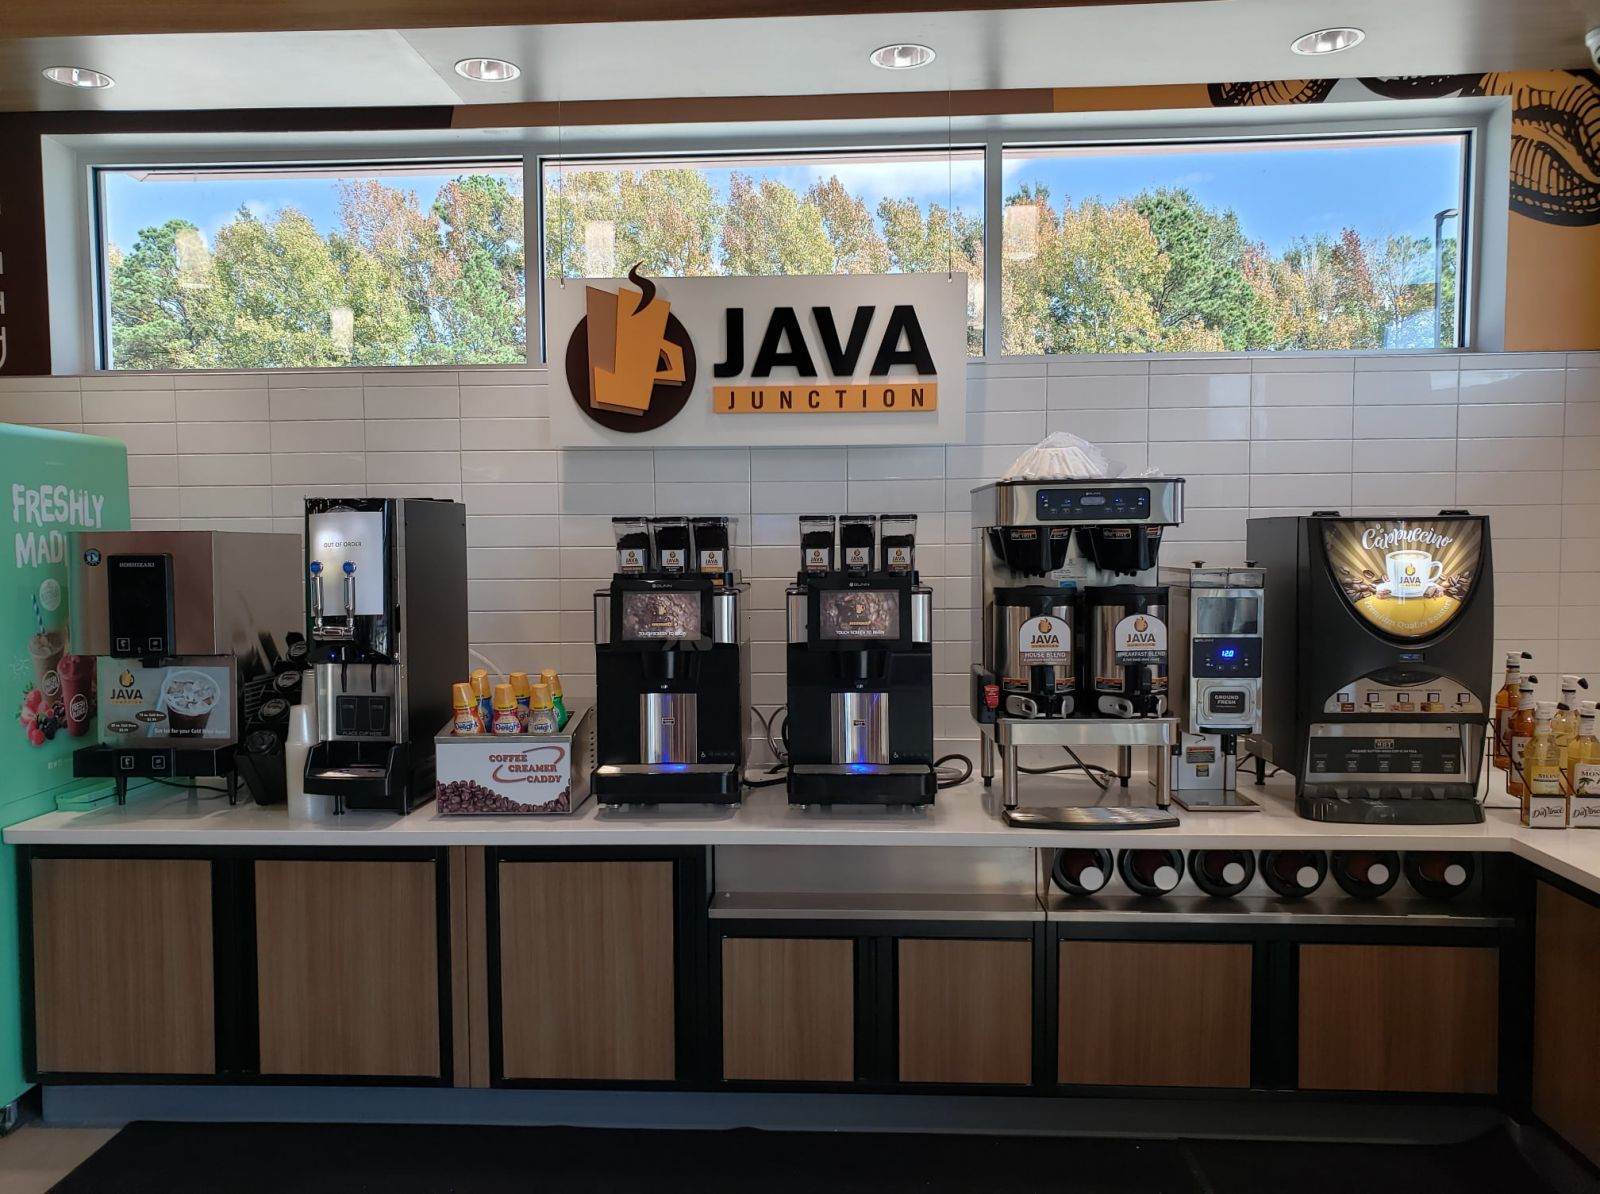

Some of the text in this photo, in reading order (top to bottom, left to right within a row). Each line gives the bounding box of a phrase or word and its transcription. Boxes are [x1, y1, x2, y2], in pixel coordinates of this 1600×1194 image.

[713, 304, 938, 379] JAVA
[727, 387, 925, 410] JUNCTION
[11, 483, 105, 529] FRESHLY
[1362, 527, 1453, 550] Cappuccino
[15, 530, 68, 569] MAD
[1400, 576, 1421, 584] JAVA
[1030, 634, 1060, 644] JAVA
[1126, 633, 1156, 643] JAVA
[110, 688, 144, 700] JAVA
[455, 721, 478, 732] Delight
[495, 721, 520, 733] Delight
[488, 754, 528, 763] COFFEE
[508, 764, 557, 773] CREAMER
[526, 775, 562, 783] CADDY
